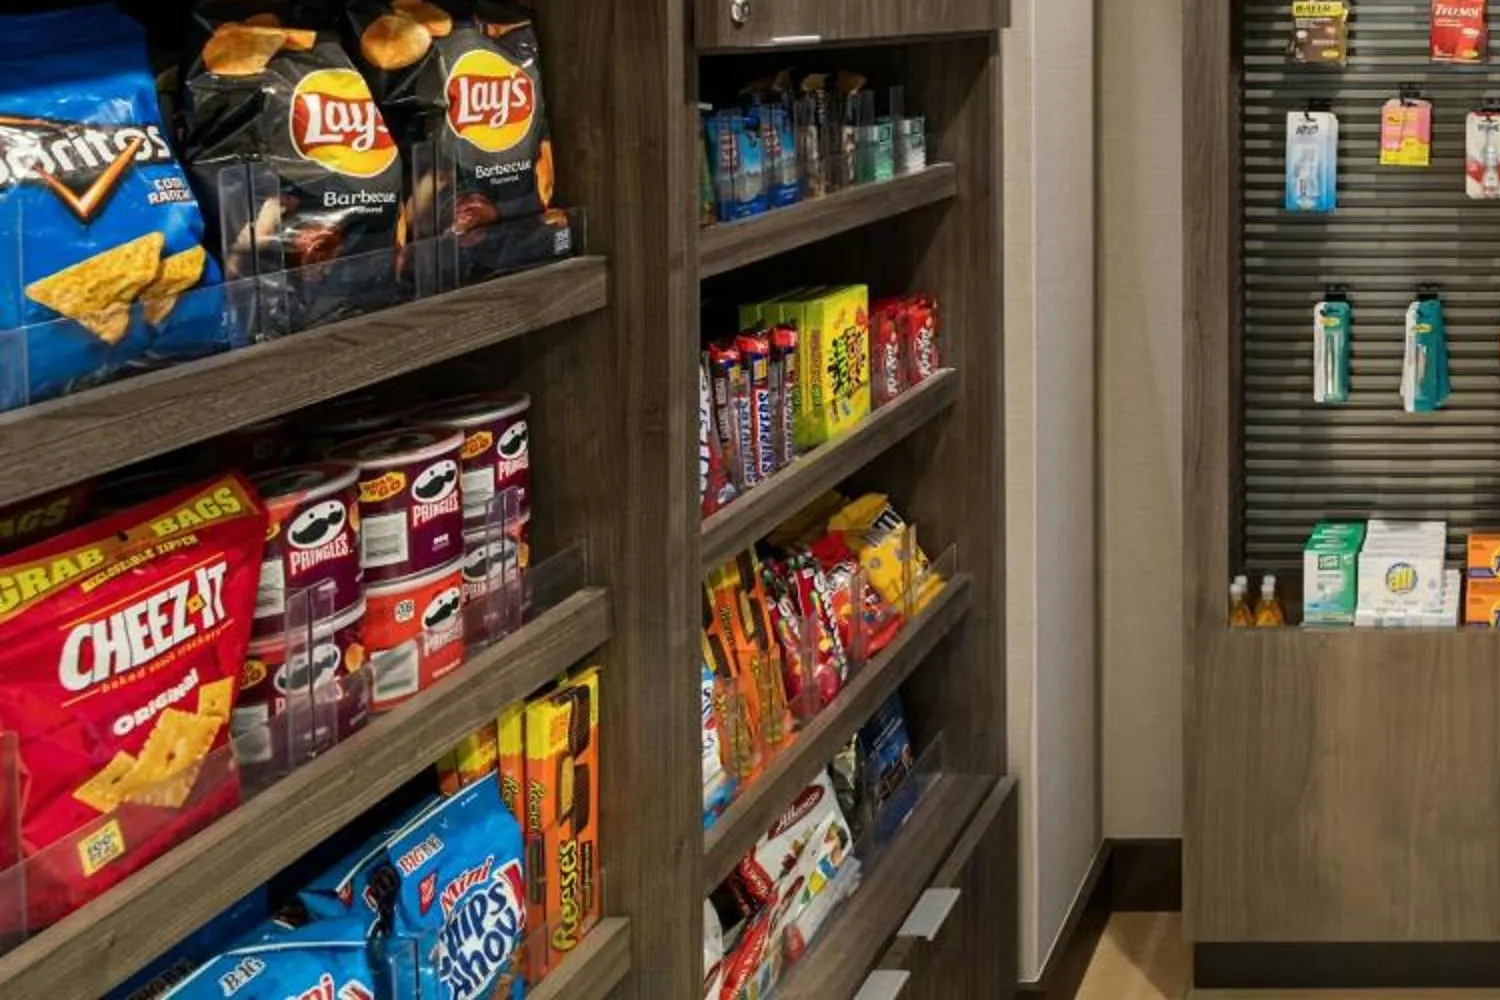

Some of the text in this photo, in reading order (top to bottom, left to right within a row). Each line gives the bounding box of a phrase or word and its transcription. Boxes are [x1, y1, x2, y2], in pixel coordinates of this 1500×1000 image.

[457, 70, 527, 128] Lay's
[475, 158, 532, 179] Barbecue
[323, 189, 396, 207] Barbecue
[757, 390, 774, 473] SNICKERS
[152, 487, 241, 537] BAGS
[290, 532, 349, 576] PRINGLES
